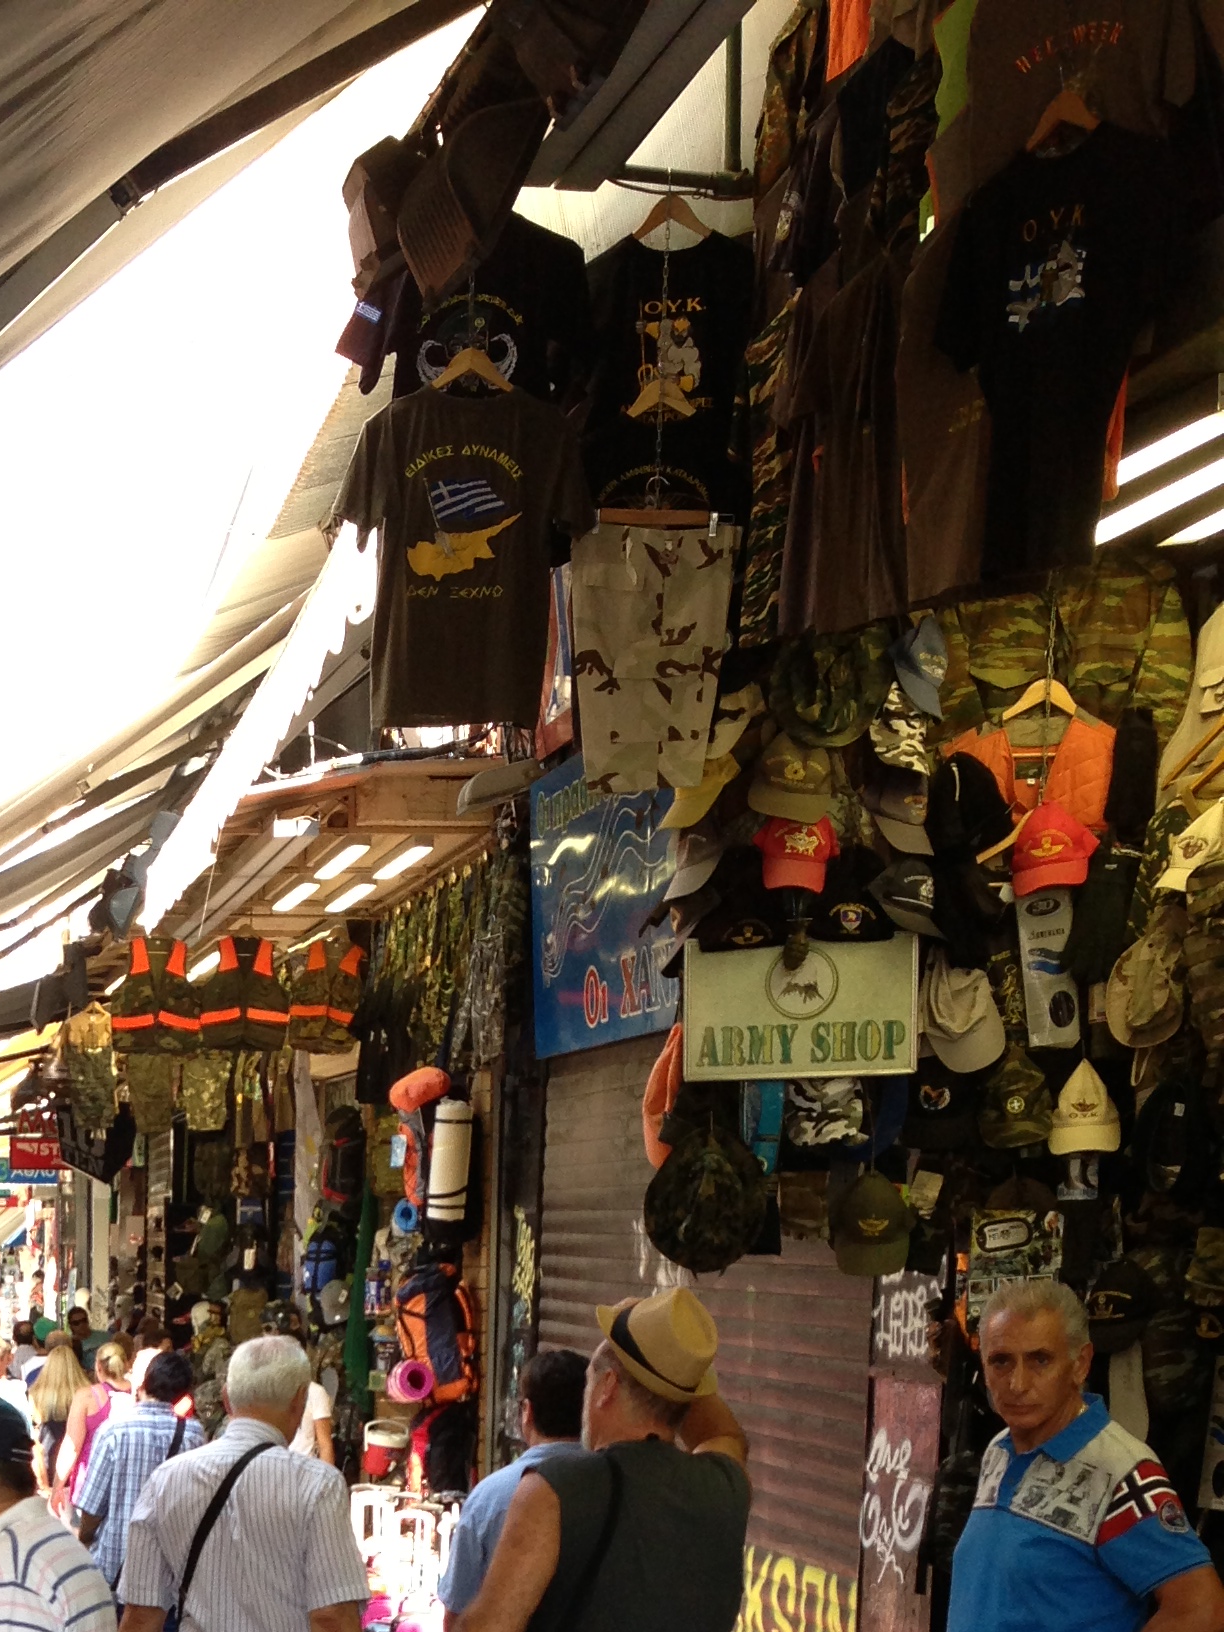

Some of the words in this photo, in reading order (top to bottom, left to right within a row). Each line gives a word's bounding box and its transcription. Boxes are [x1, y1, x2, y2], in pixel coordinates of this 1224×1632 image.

[404, 444, 455, 479] ΕΙΔΙΚΕΣ
[461, 443, 525, 482] ΔΥΝΑΜΕΙΣ
[406, 583, 439, 599] ΔΕΝ
[696, 1024, 799, 1067] ARMY
[809, 1019, 907, 1064] SHOP
